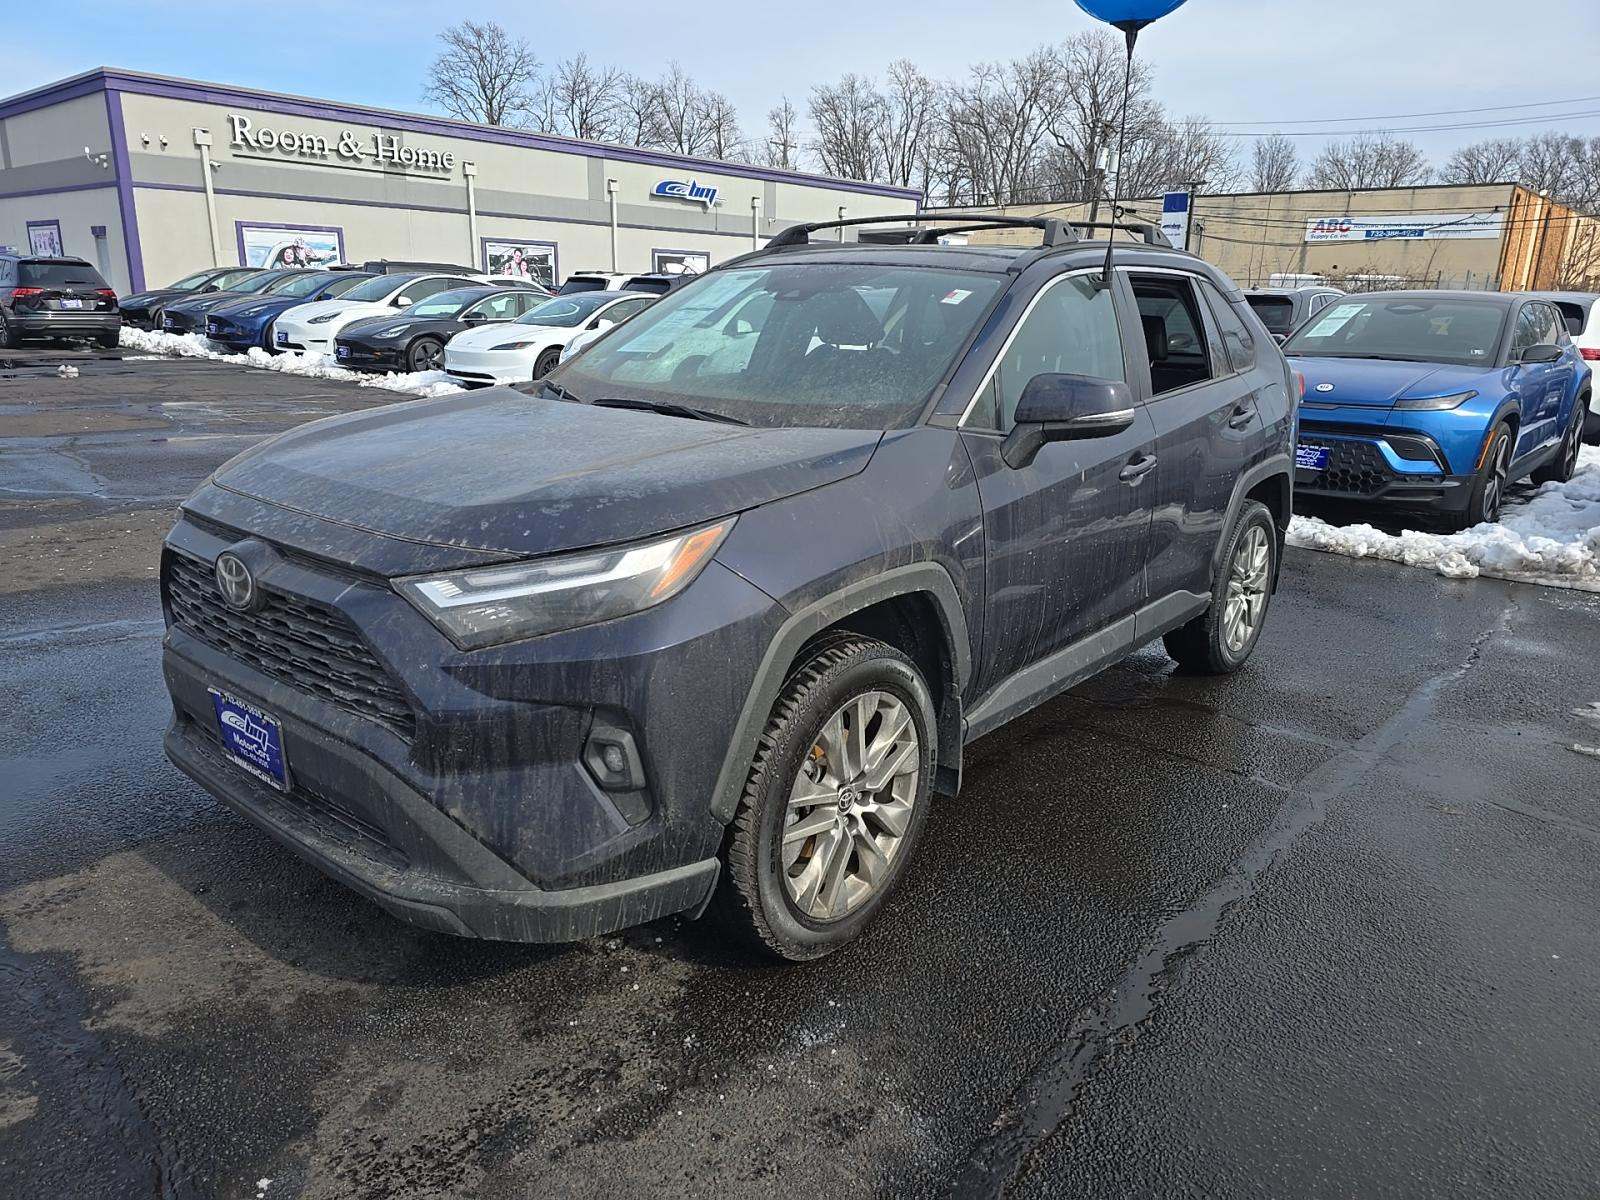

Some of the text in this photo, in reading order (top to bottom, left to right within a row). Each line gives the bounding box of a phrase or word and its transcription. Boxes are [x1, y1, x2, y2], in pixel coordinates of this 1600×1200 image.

[228, 114, 455, 169] Room & Home
